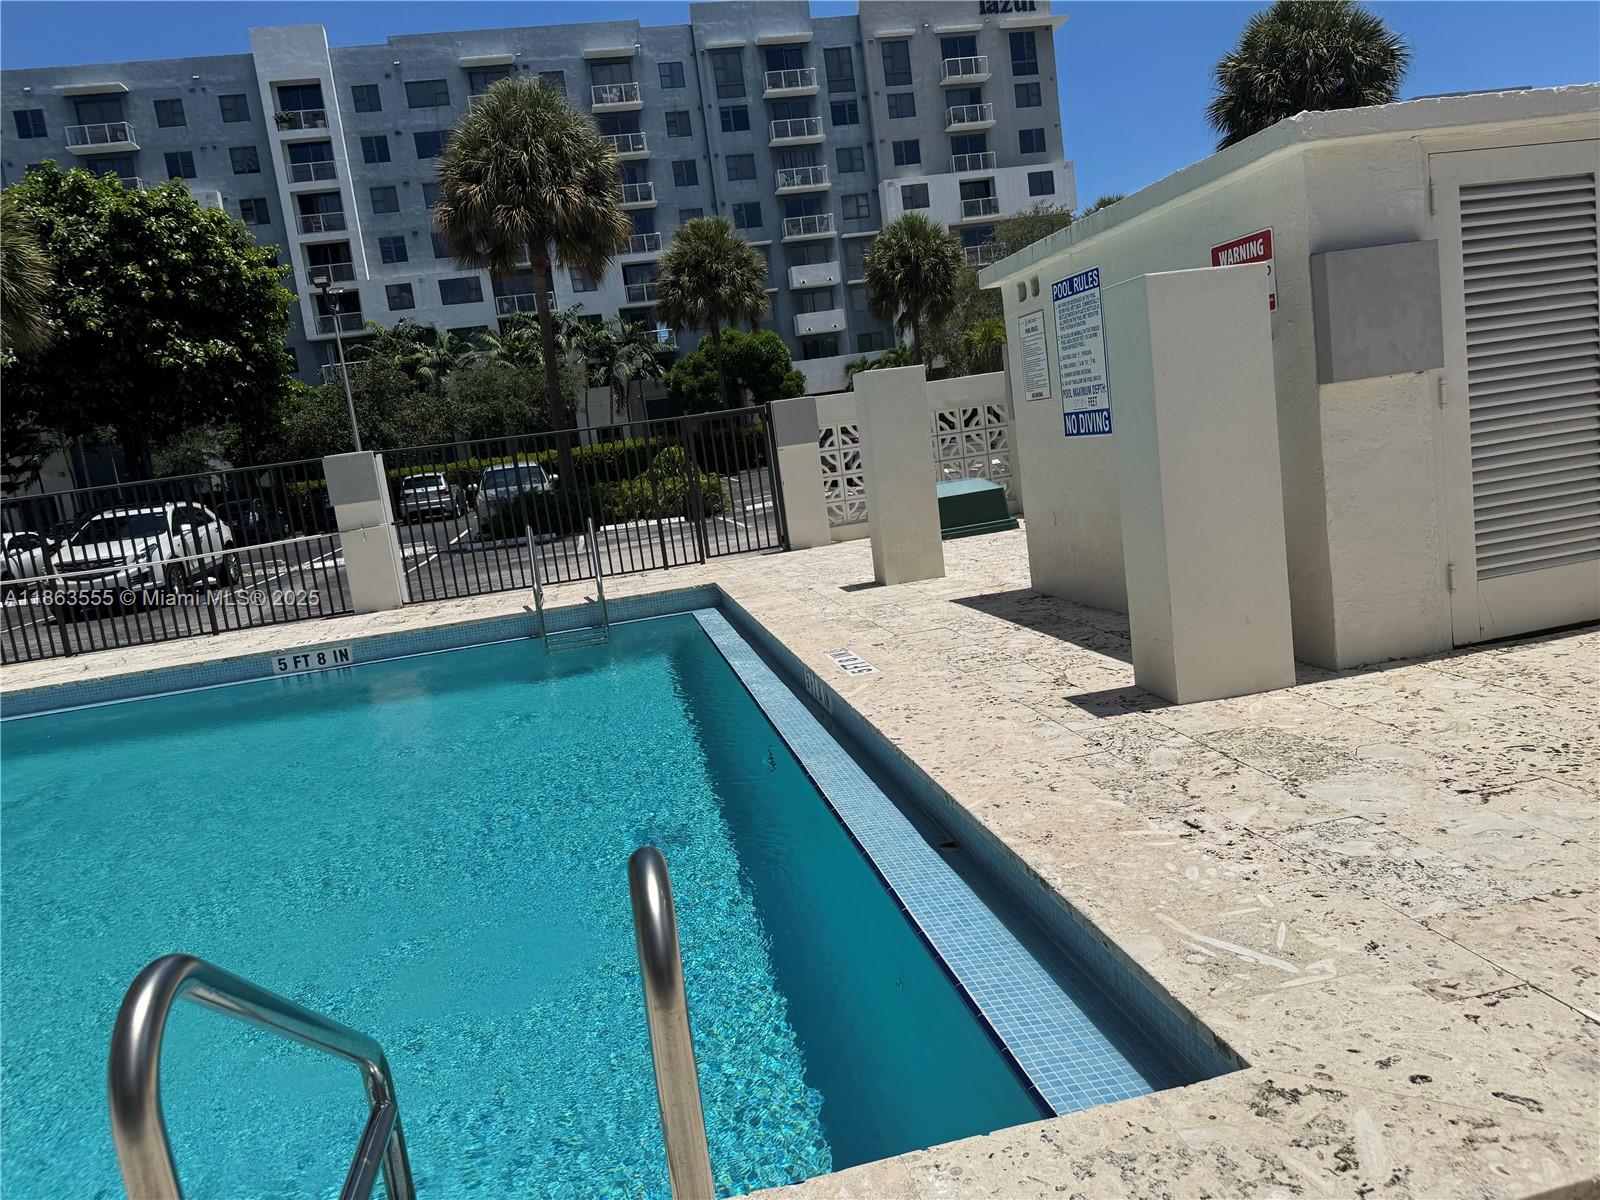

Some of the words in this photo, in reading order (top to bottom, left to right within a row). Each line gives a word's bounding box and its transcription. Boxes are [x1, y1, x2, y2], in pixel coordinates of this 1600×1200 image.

[1218, 238, 1264, 266] WARNING
[1053, 282, 1072, 299] POOL
[1073, 270, 1098, 293] RULES
[1062, 388, 1072, 398] POOL
[1072, 385, 1091, 397] MAXIMUM
[1088, 396, 1097, 406] FEET
[1065, 414, 1077, 434] NO
[1078, 411, 1109, 433] DIVING
[278, 658, 287, 671] 5
[293, 654, 310, 669] FT
[317, 653, 326, 665] 8
[333, 648, 349, 663] IN
